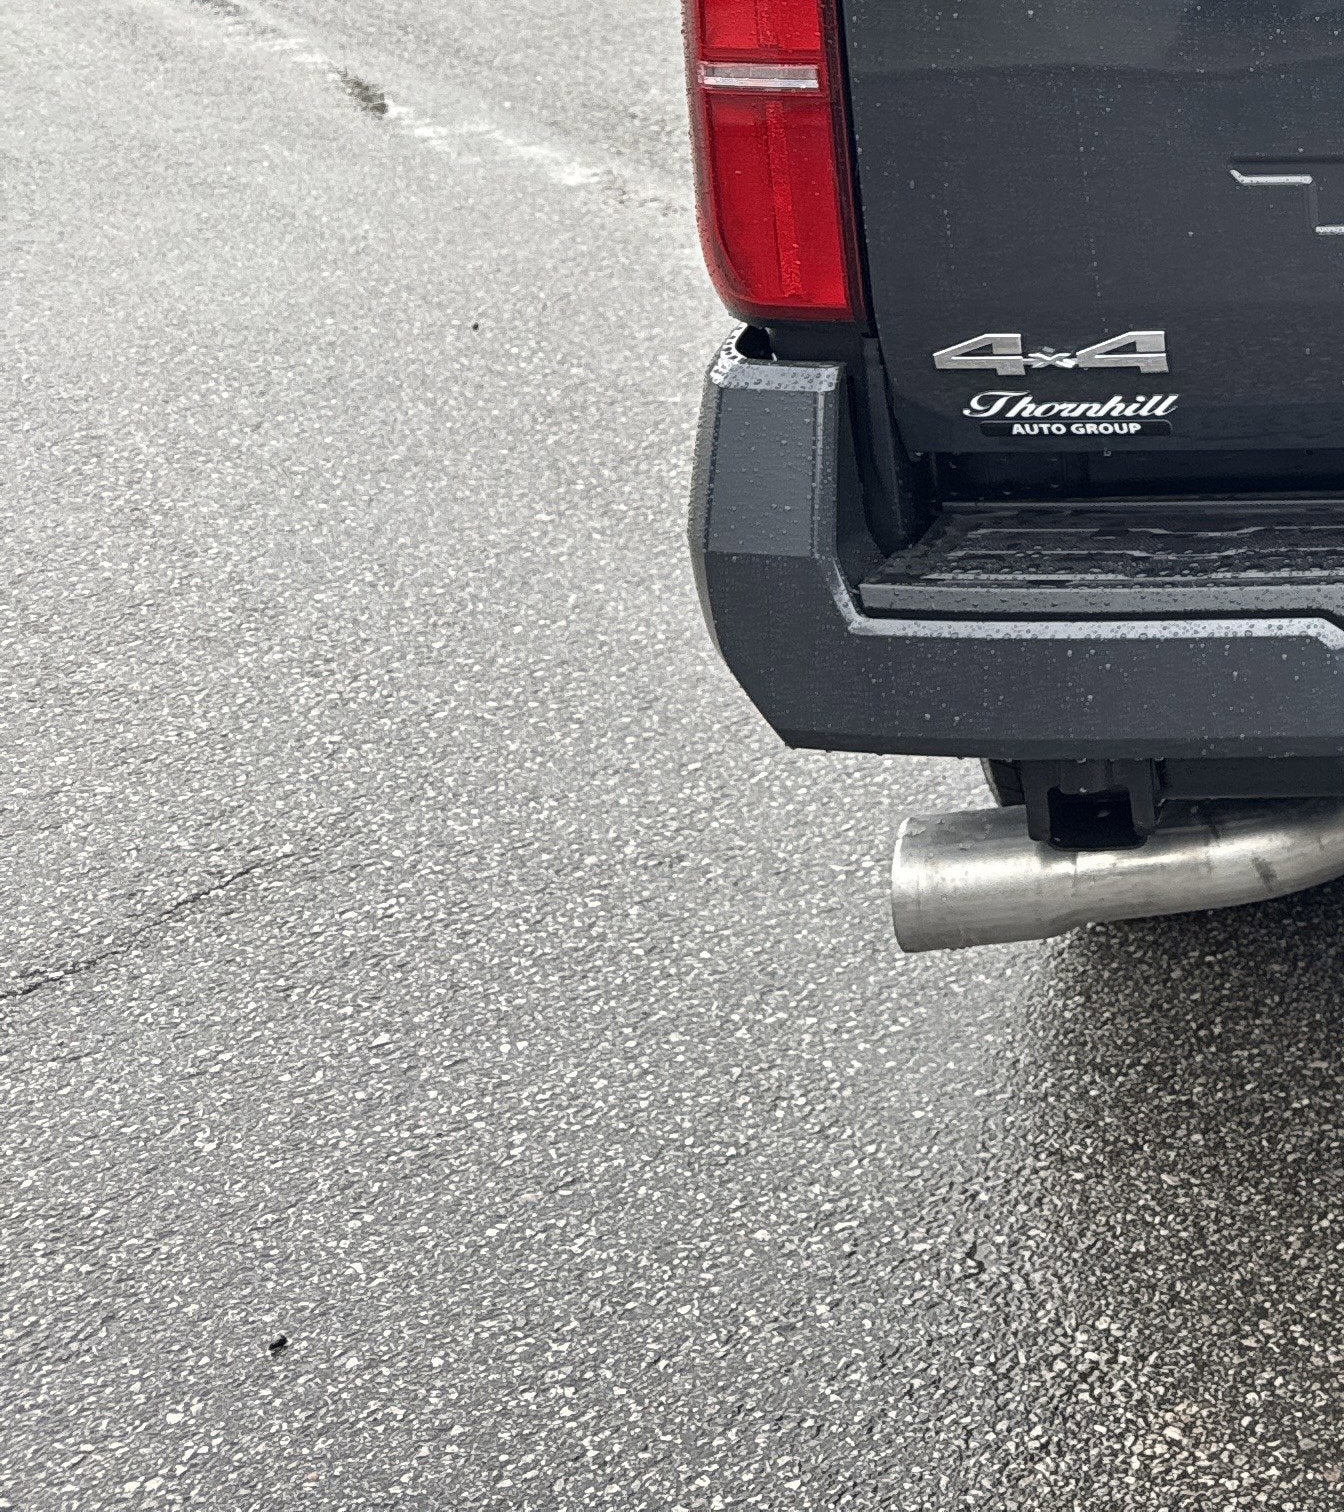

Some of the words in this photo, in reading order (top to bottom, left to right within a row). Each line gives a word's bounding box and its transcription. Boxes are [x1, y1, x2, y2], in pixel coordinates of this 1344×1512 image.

[932, 330, 1169, 376] 4x4
[962, 390, 1180, 419] Thornhill
[1011, 422, 1068, 436] AUTO
[1070, 421, 1143, 436] GROUP
